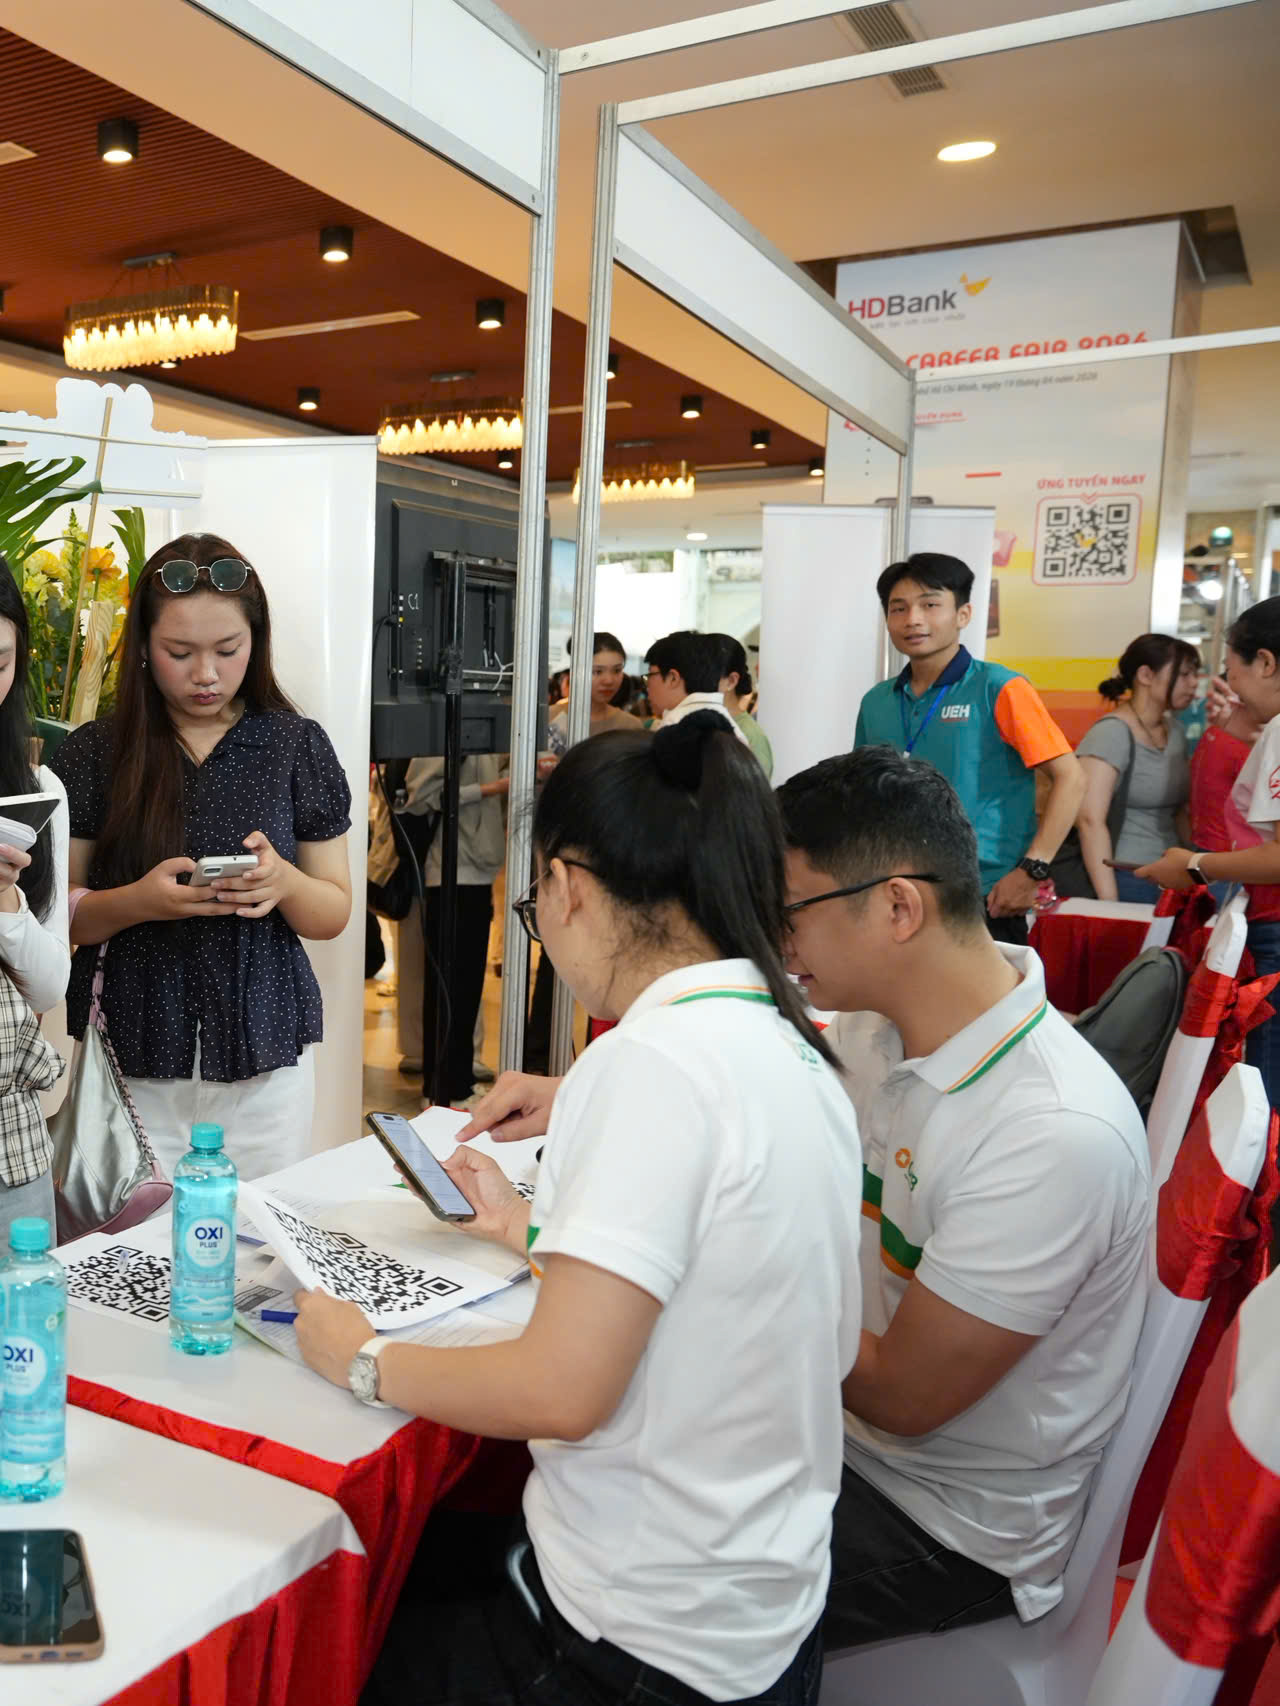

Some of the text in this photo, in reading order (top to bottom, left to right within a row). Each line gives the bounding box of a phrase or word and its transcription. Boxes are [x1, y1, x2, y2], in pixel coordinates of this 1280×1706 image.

[848, 289, 958, 319] HDBank
[1111, 473, 1147, 486] NGAY
[941, 703, 971, 719] UEH
[195, 1226, 224, 1240] OXI
[199, 1241, 219, 1249] PLUS
